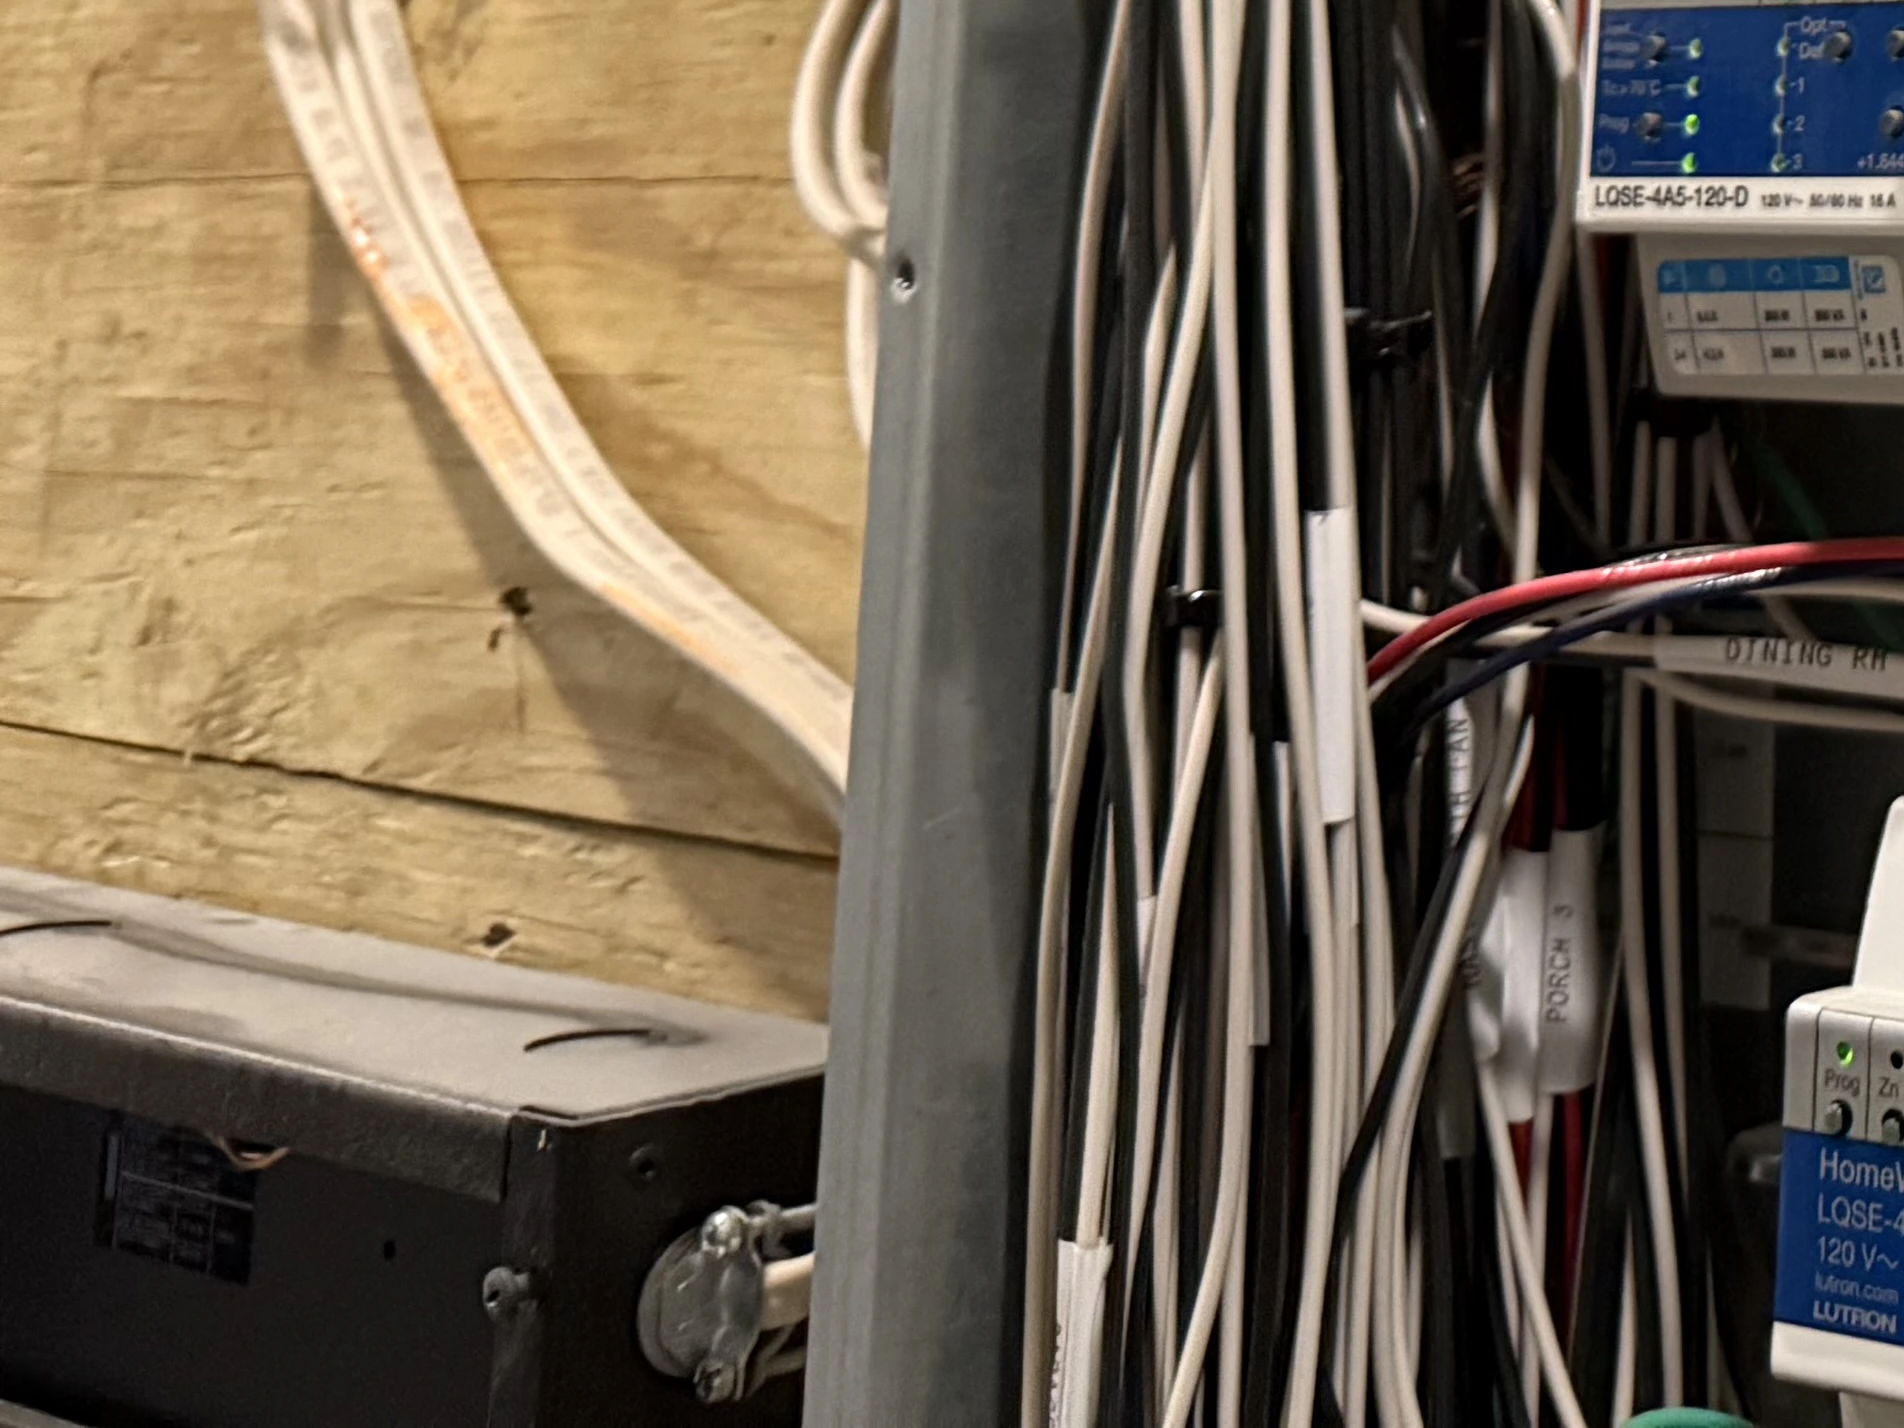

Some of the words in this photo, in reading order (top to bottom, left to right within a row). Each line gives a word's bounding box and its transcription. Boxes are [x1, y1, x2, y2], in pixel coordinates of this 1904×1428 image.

[1595, 182, 1749, 208] LQSE-4A5-120-D
[1726, 638, 1833, 668] DINING
[1545, 937, 1572, 1024] PORCH
[1825, 1069, 1860, 1096] Prog
[1879, 1078, 1902, 1097] Zn
[1817, 1236, 1855, 1267] 120
[1815, 1272, 1899, 1305] lutron.com
[1813, 1301, 1897, 1335] LUTRON
